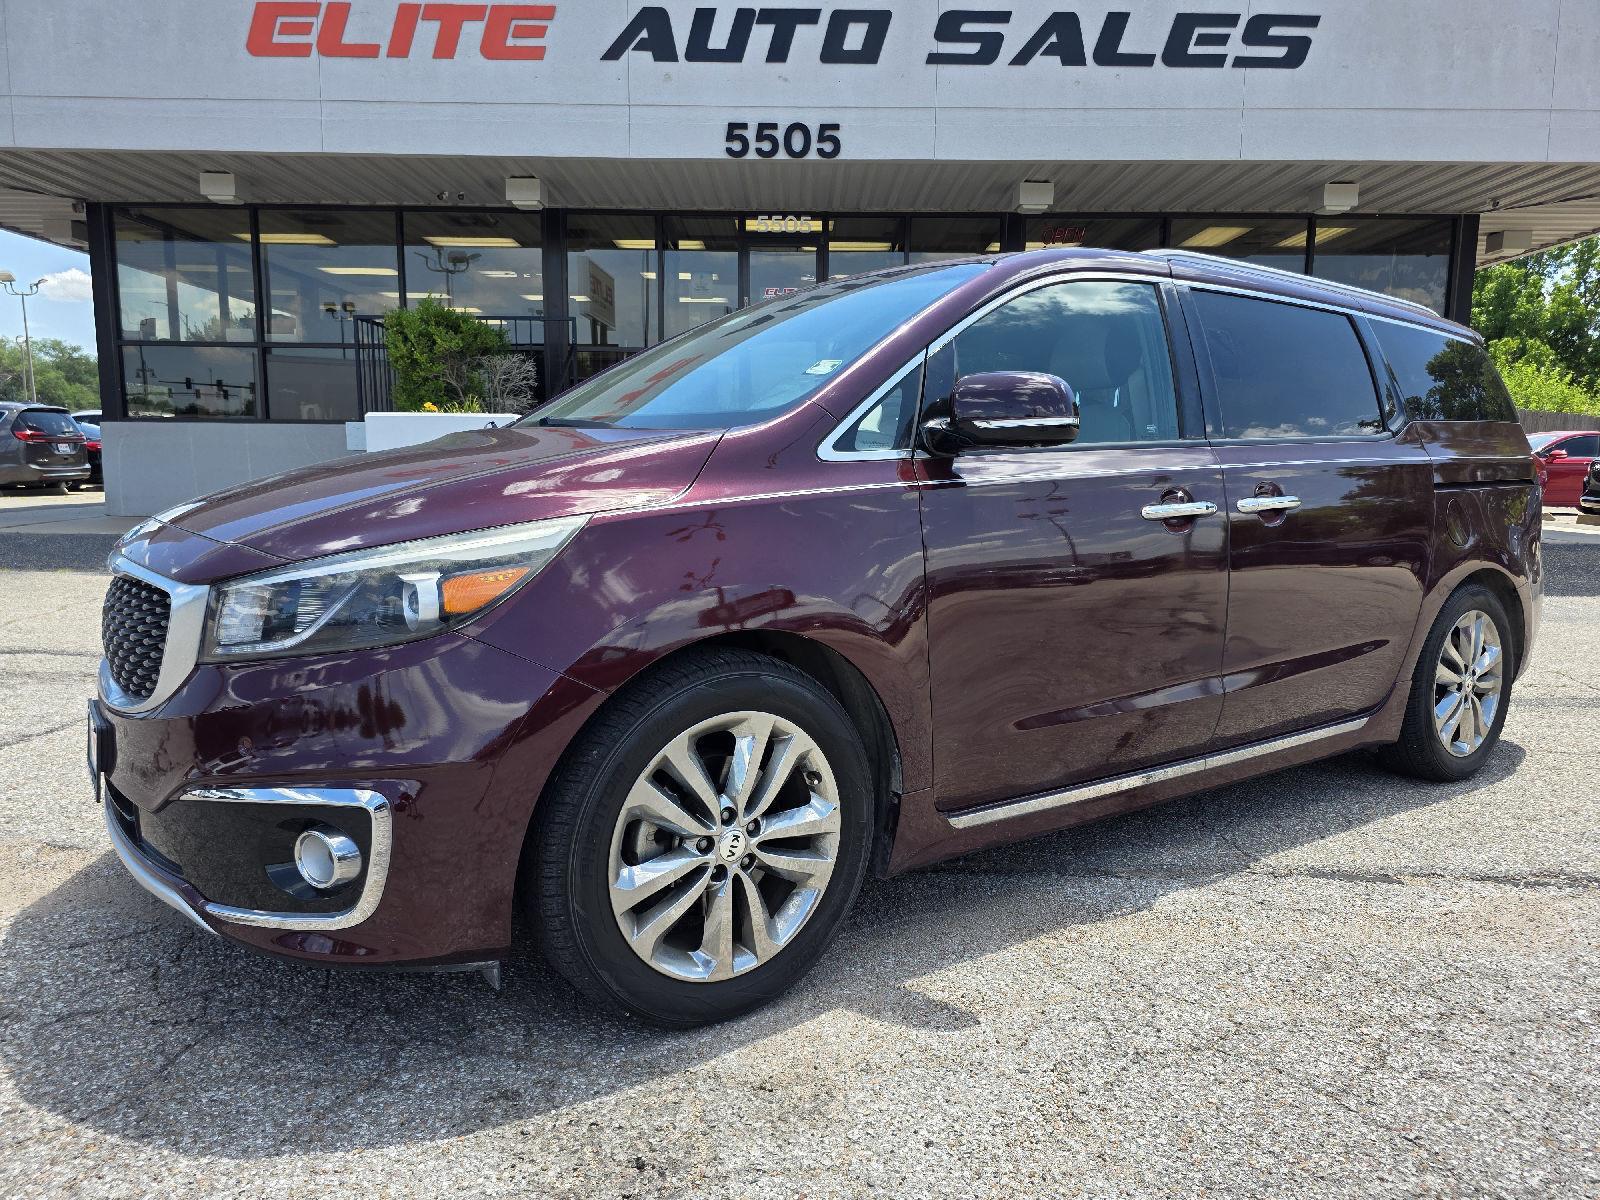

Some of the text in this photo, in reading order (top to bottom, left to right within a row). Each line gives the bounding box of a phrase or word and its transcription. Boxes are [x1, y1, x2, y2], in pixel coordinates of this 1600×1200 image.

[246, 1, 1321, 69] ELITE AUTO SALES
[725, 123, 841, 158] 5505
[756, 215, 812, 233] 5505
[1042, 226, 1086, 245] OPEN
[726, 834, 741, 858] KIA
